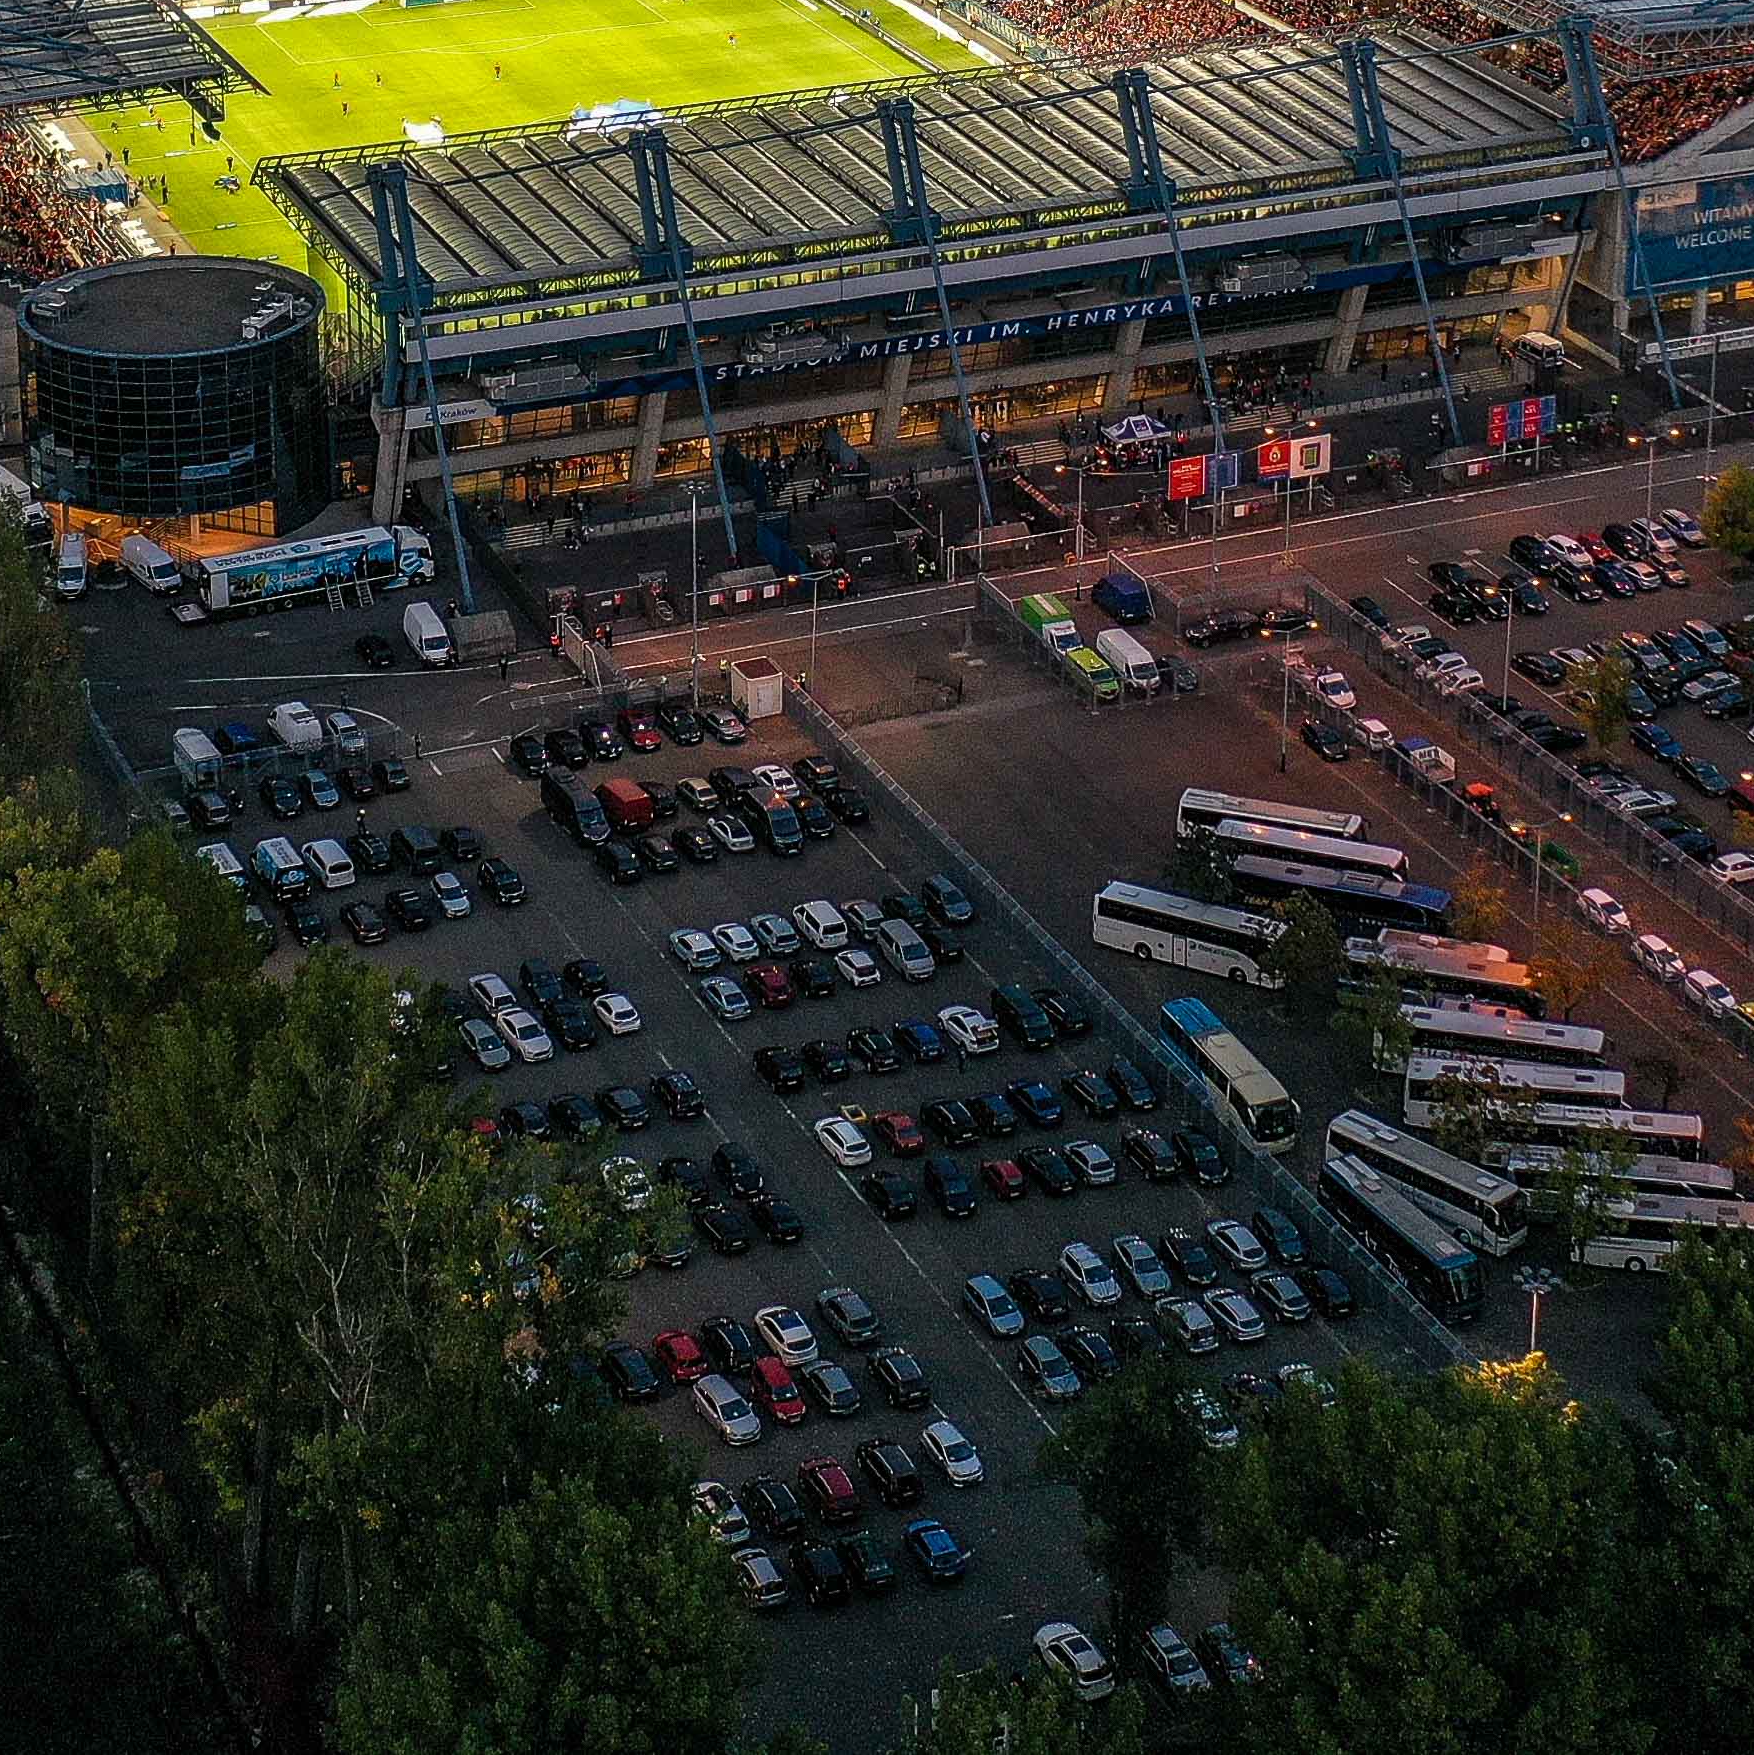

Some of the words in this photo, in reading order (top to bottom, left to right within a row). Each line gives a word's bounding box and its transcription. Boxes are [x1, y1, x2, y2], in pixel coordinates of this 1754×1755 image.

[1693, 203, 1754, 224] WITAMY
[1675, 225, 1752, 249] WELCOME
[1047, 299, 1175, 330] HENRYKA
